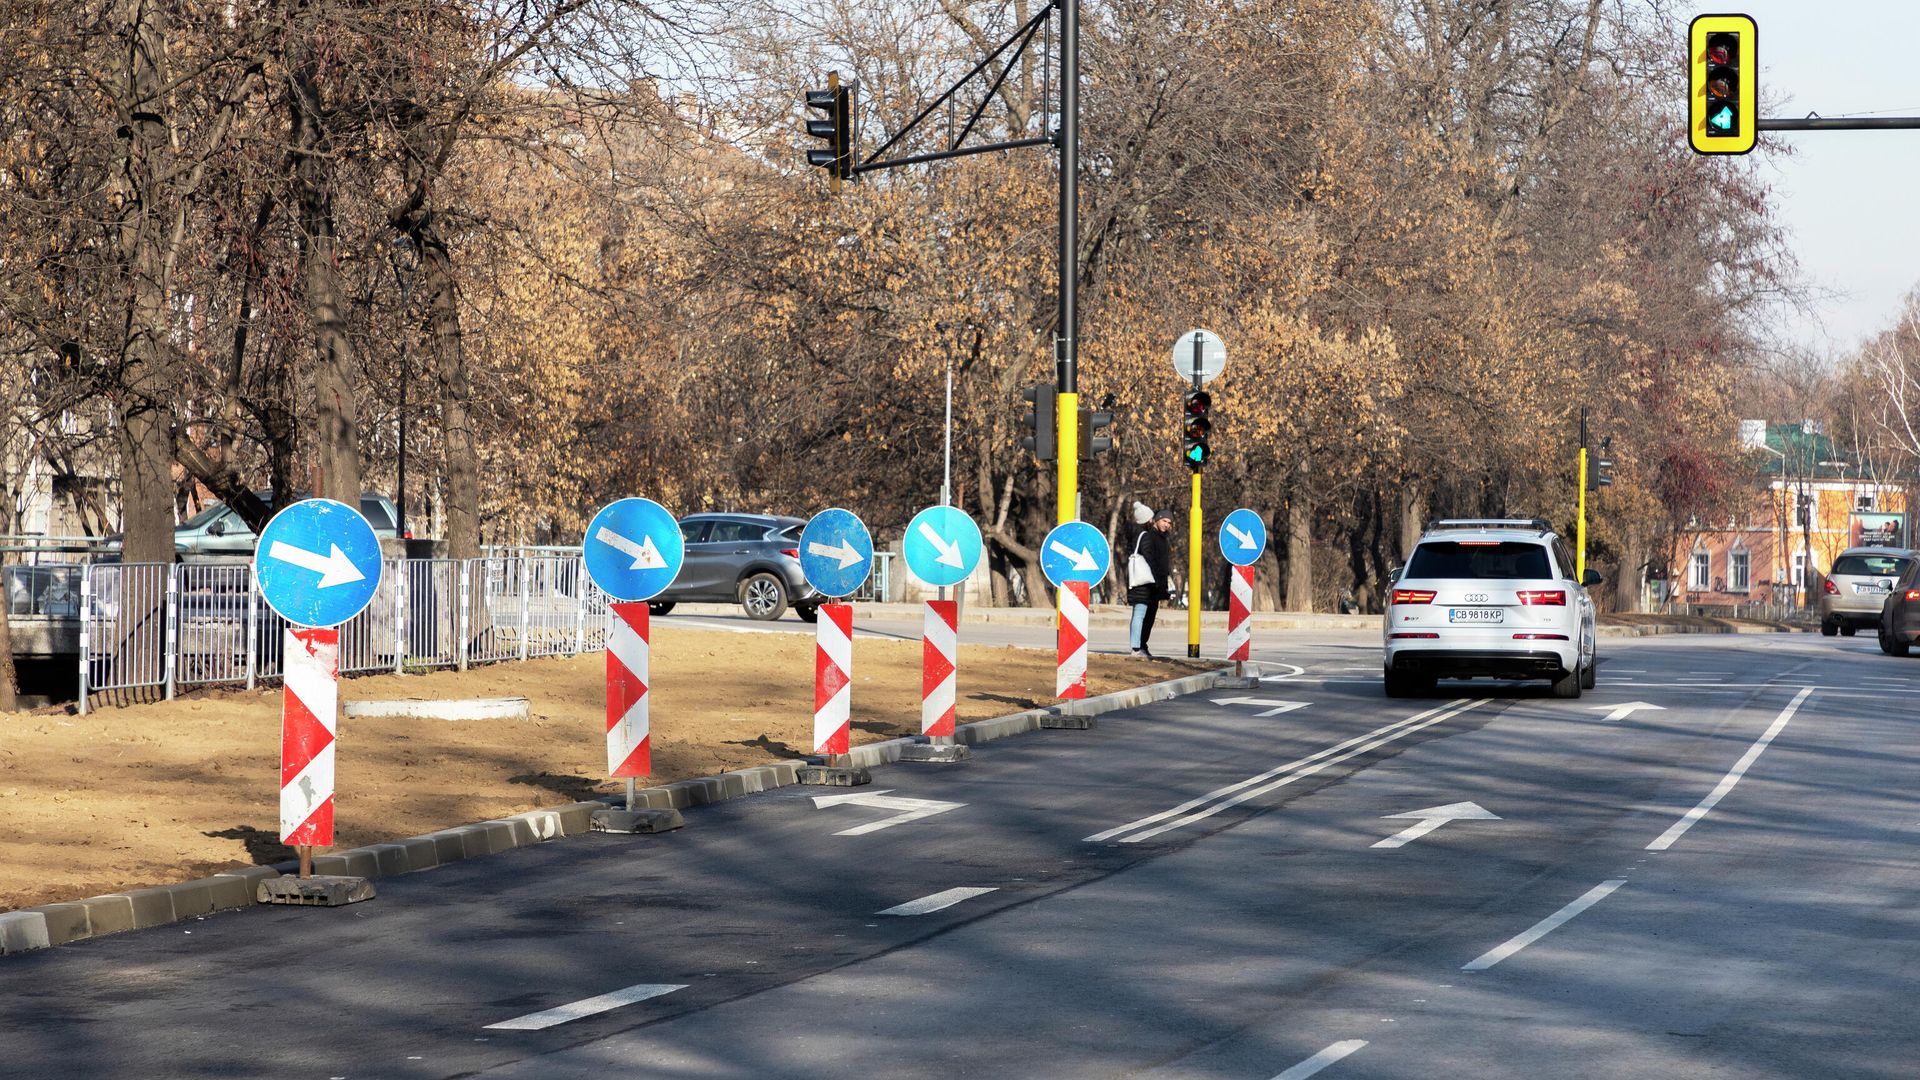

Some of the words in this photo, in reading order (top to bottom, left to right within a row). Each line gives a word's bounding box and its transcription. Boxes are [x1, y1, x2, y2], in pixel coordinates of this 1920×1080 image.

[1455, 610, 1467, 619] CB
[1468, 610, 1489, 619] 9818
[1490, 610, 1502, 619] KP
